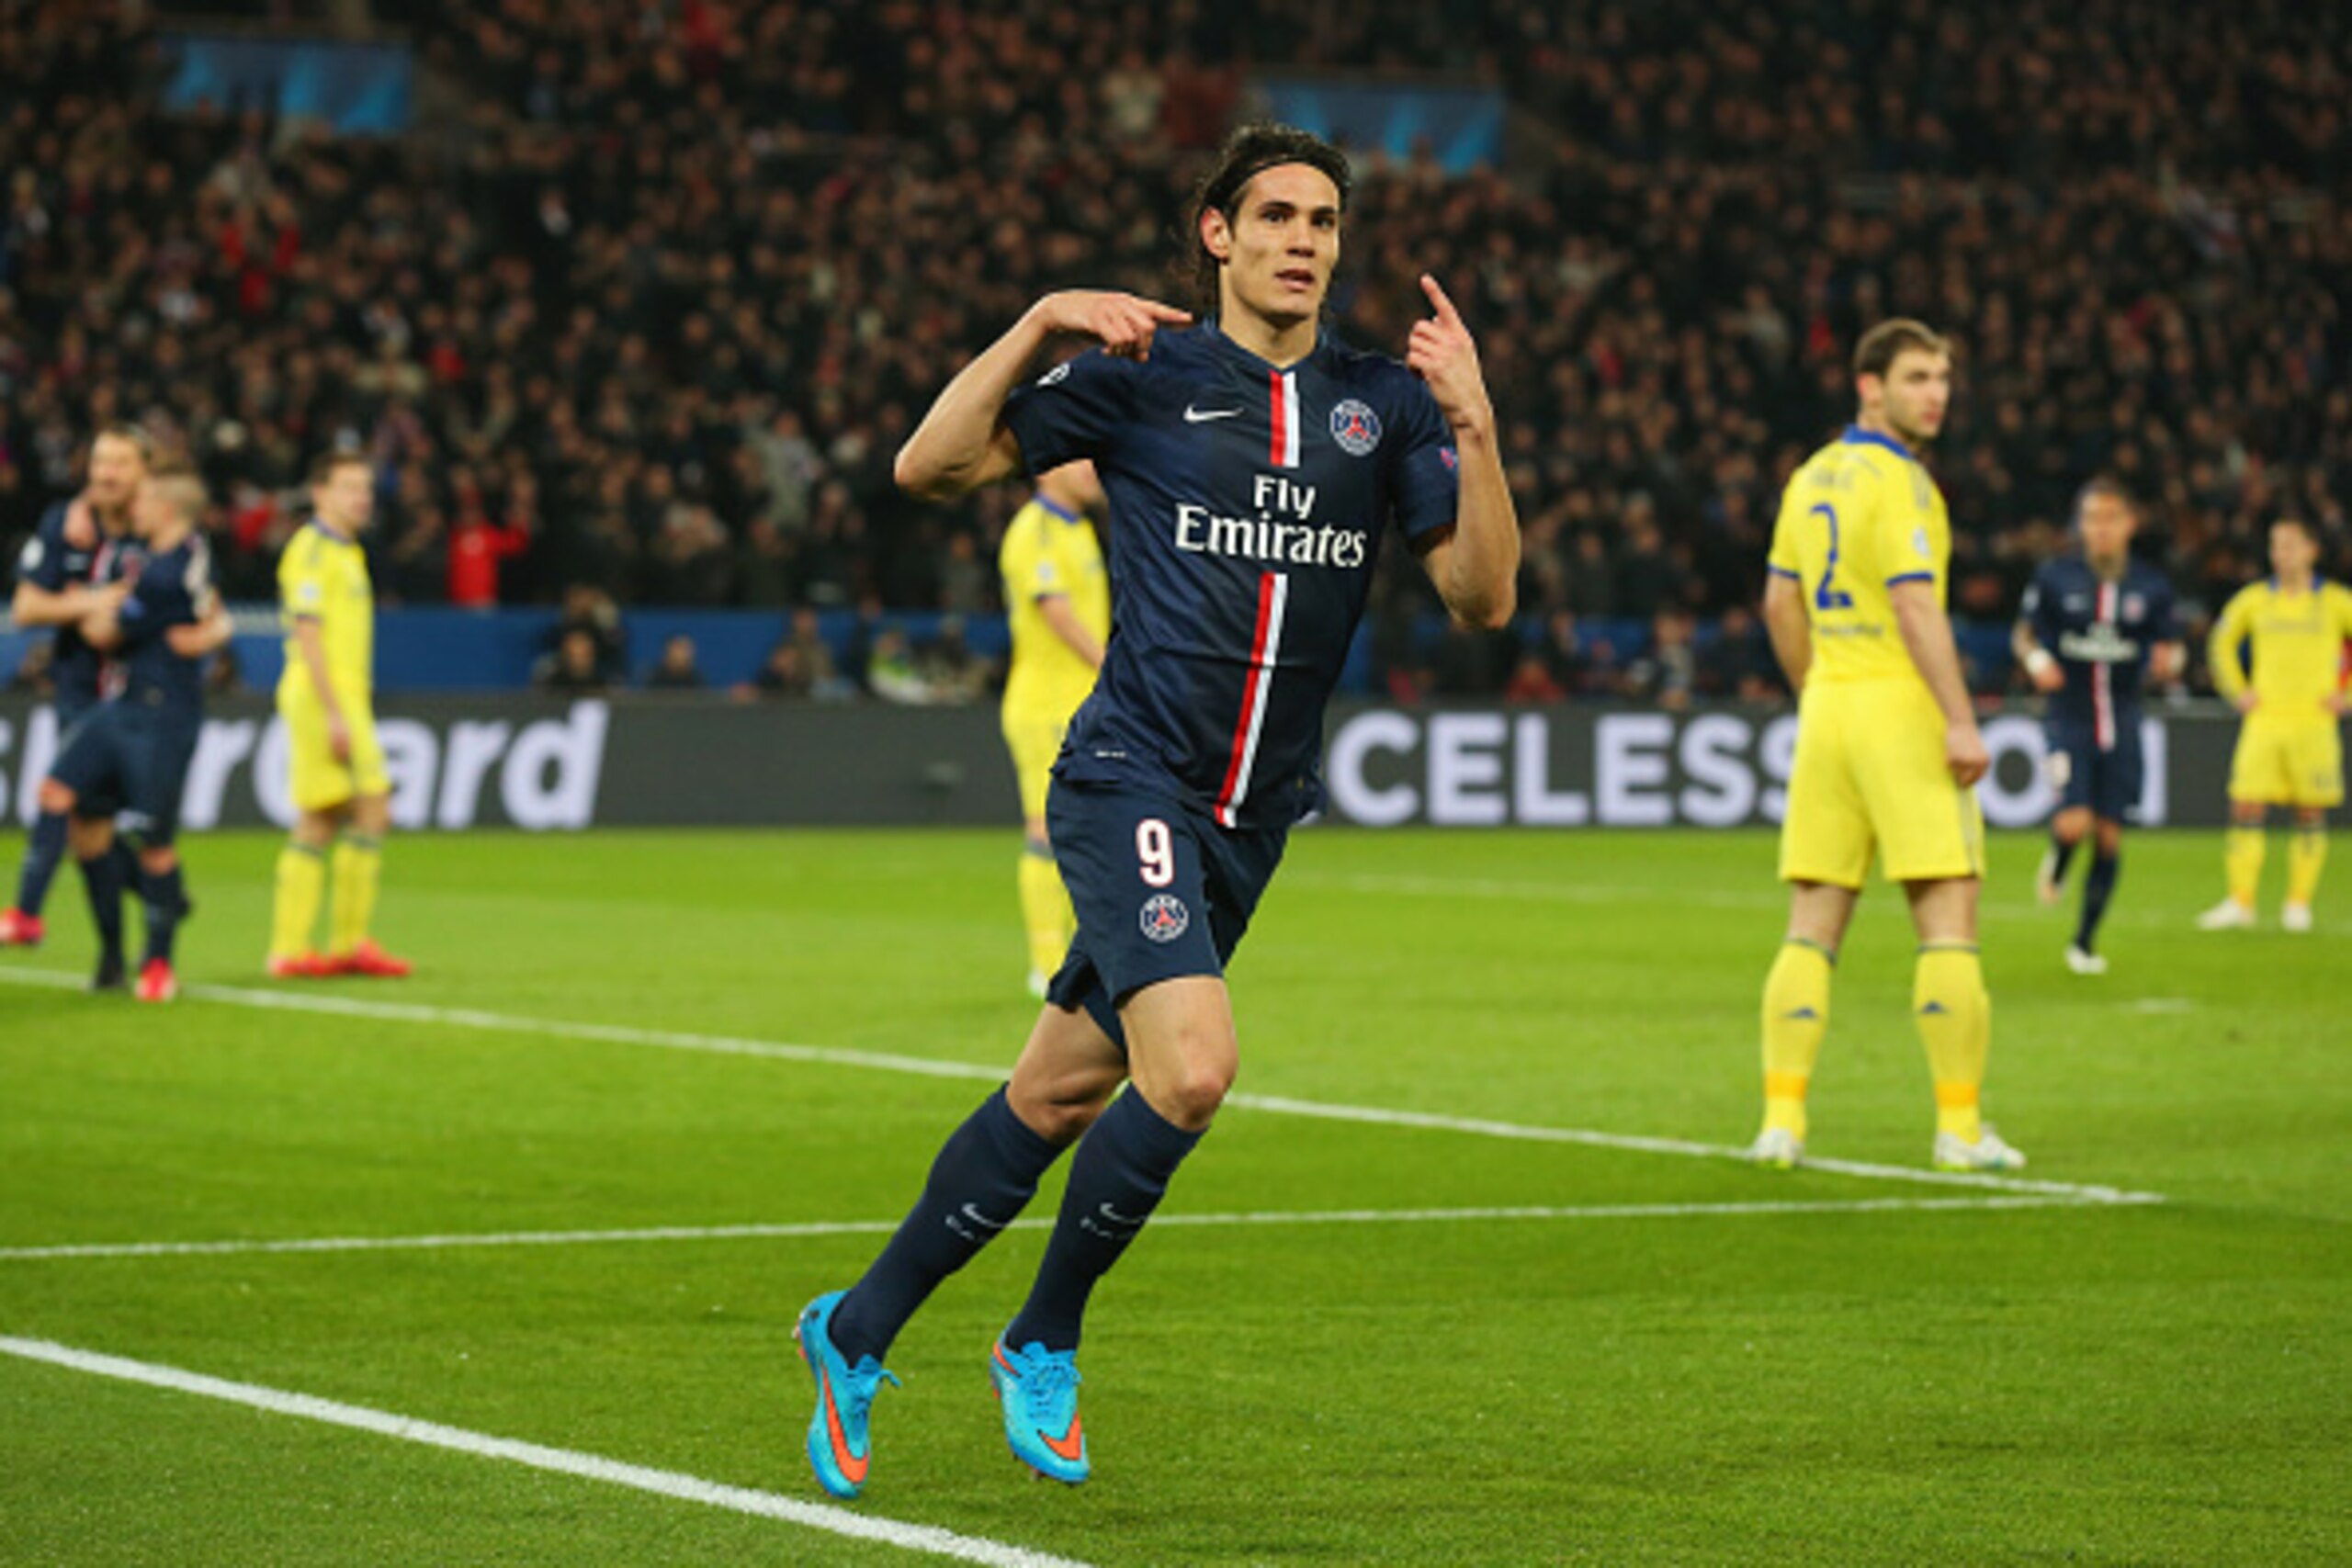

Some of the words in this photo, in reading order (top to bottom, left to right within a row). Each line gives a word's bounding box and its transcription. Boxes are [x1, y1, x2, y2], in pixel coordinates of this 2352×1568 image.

[1253, 473, 1317, 520] Fly
[1174, 502, 1367, 568] Emirates
[1809, 502, 1854, 610] 2
[1135, 817, 1175, 888] 9
